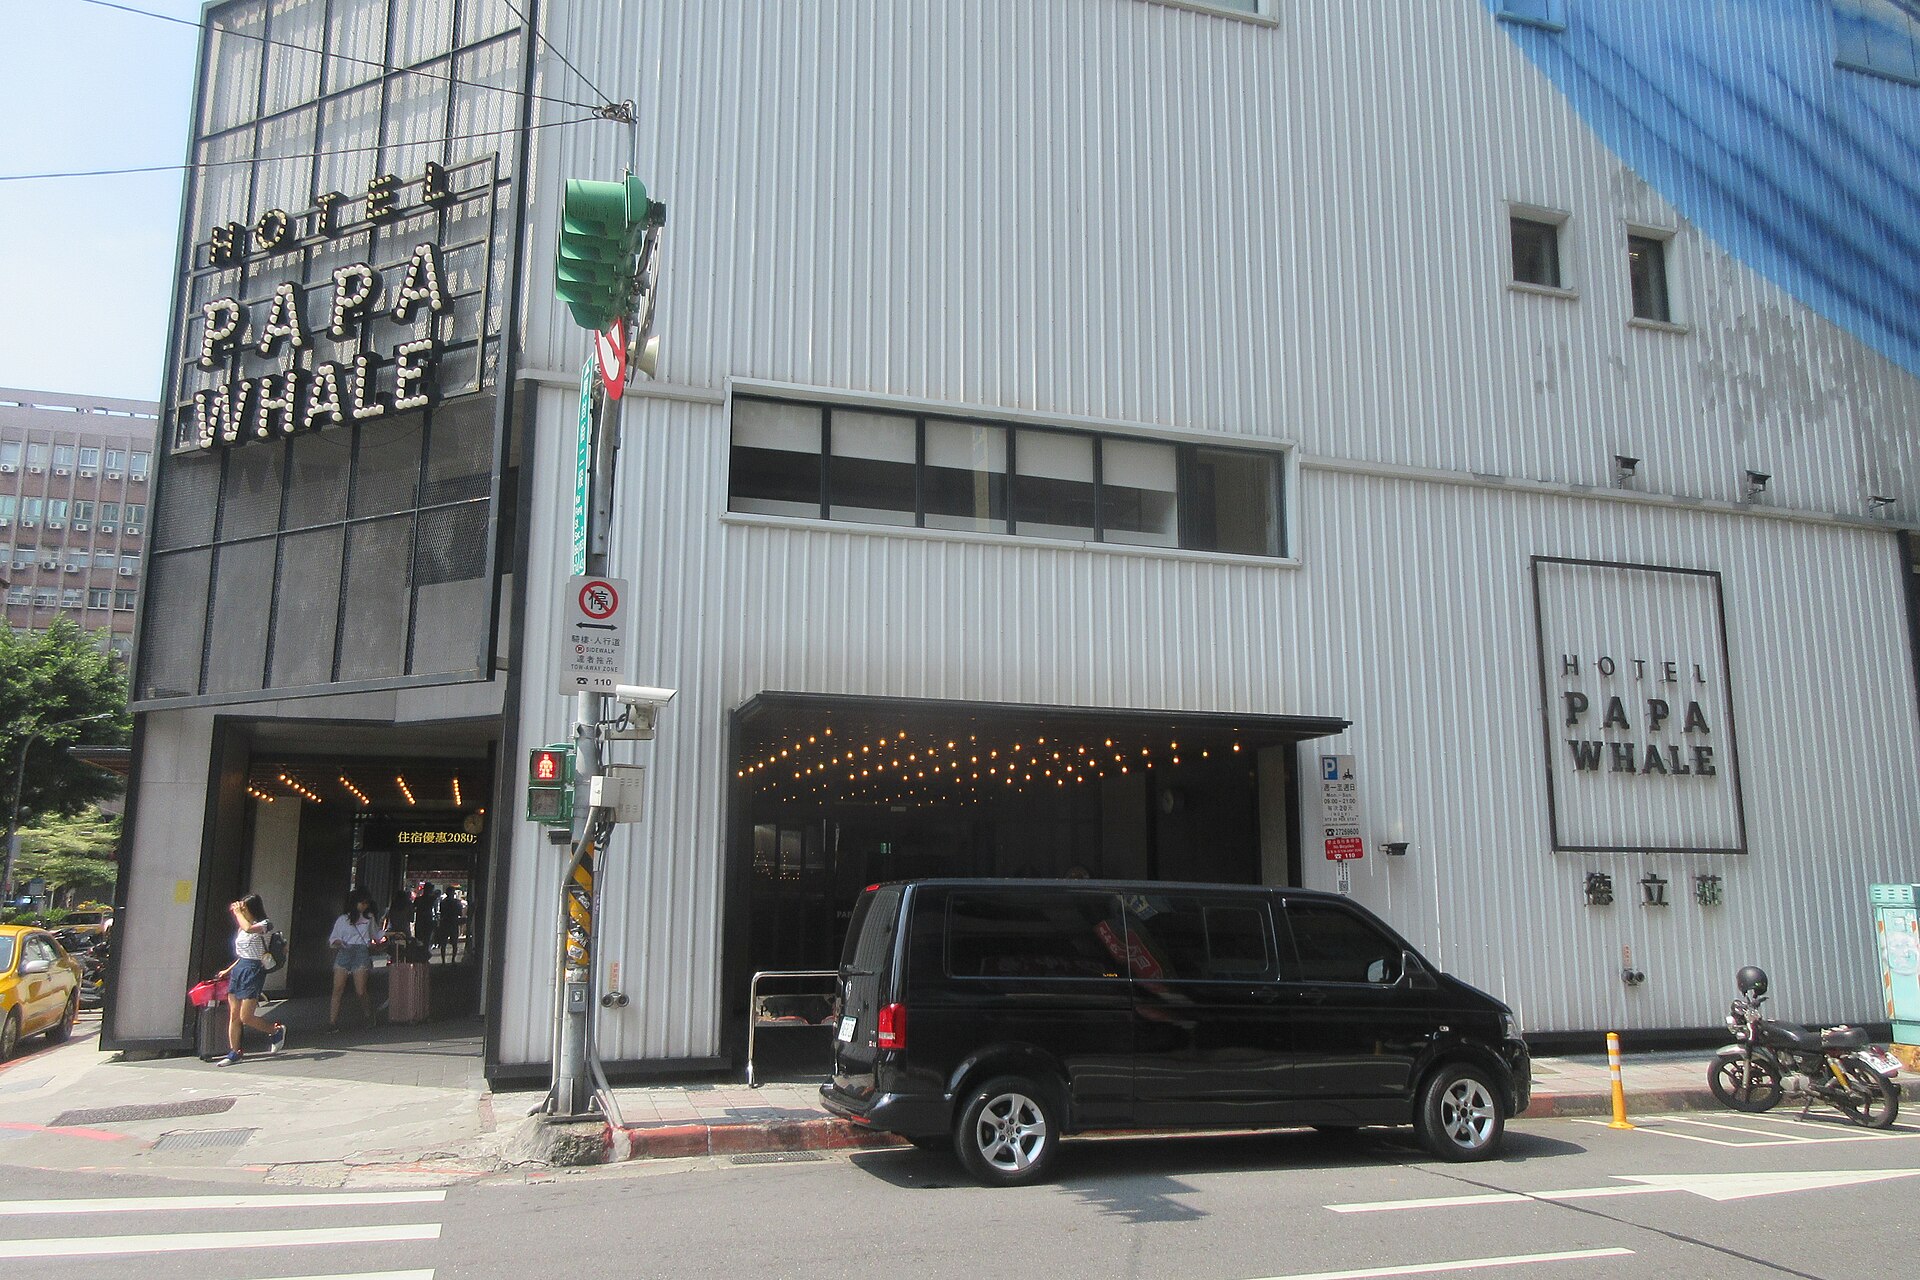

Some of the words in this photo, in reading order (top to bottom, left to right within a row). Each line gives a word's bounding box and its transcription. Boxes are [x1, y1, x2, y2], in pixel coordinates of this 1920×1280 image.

[209, 160, 454, 268] HOTEL
[198, 242, 453, 372] PAPA
[194, 338, 443, 448] WHALE
[594, 678, 612, 686] 110
[603, 665, 619, 673] ZONE
[1561, 654, 1707, 684] HOTEL
[1563, 691, 1710, 734] PAPA
[1566, 739, 1717, 776] WHALE
